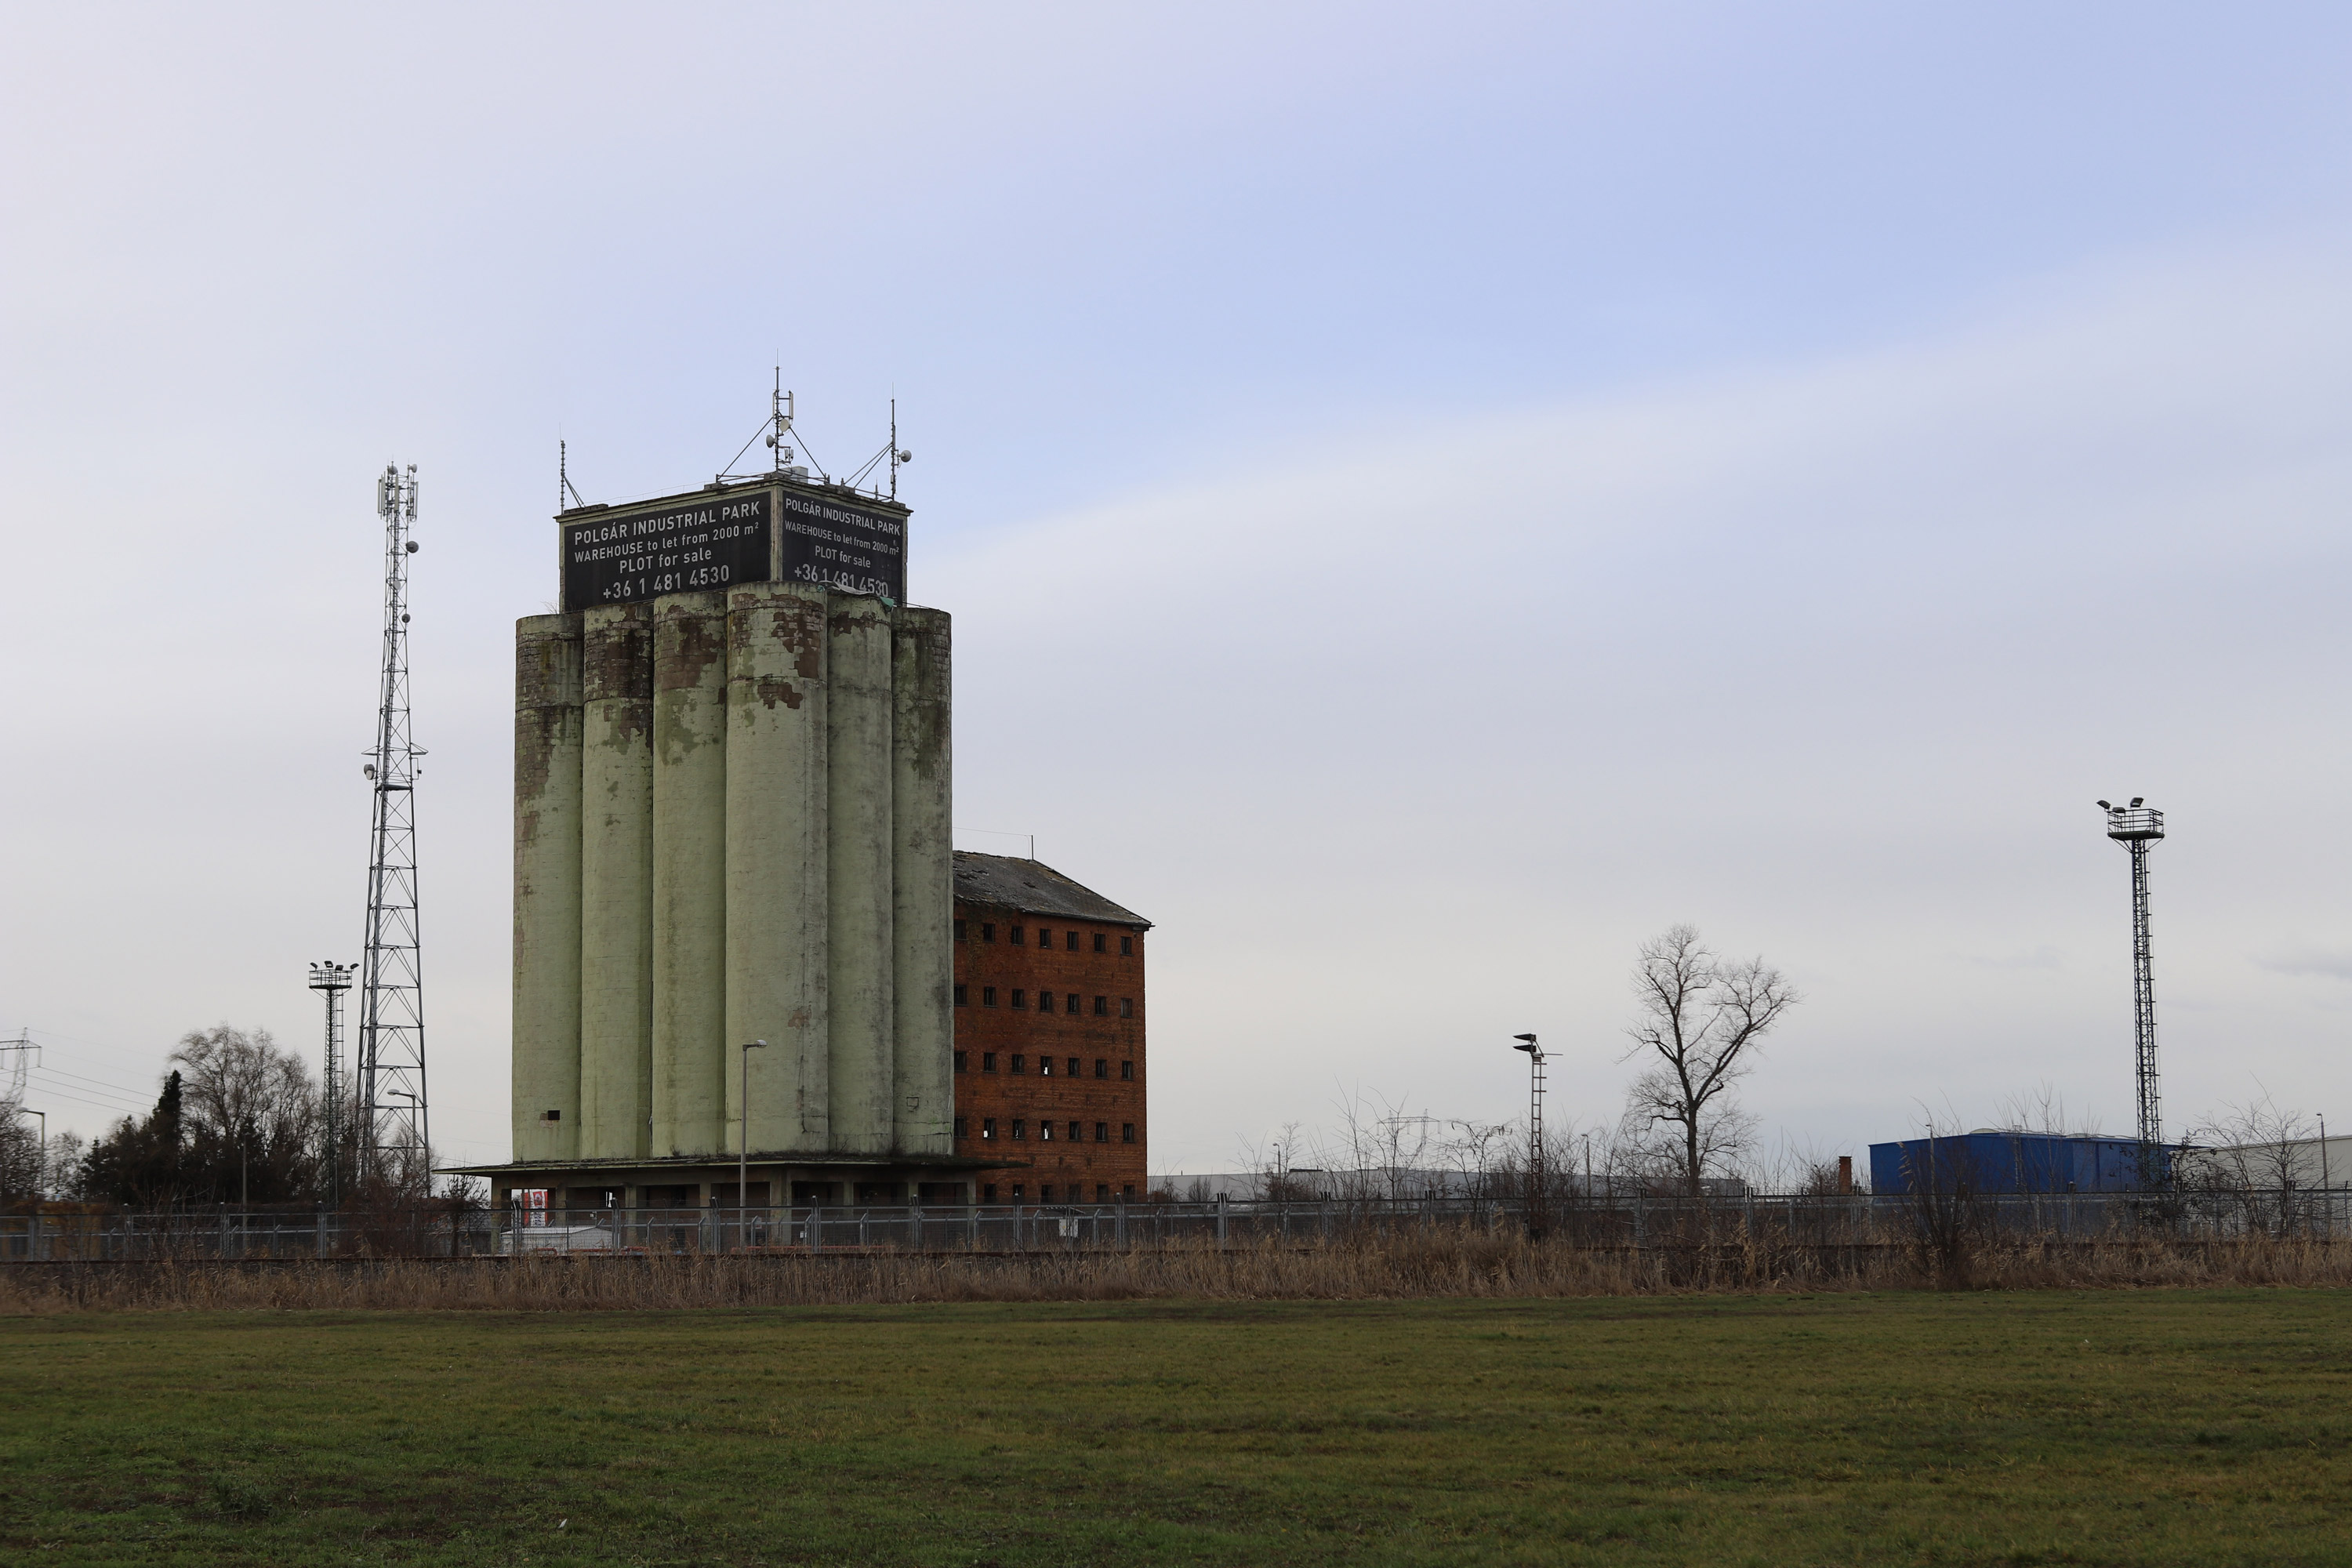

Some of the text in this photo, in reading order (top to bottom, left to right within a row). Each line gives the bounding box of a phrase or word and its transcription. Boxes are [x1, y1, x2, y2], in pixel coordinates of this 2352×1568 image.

[575, 501, 760, 545] POLGÁR INDUSTRIAL PARK
[786, 498, 901, 535] POLGÁR INDUSTRIAL PARK
[575, 541, 644, 563] WAREHOUSE
[648, 540, 658, 550] to
[662, 536, 677, 549] let
[681, 533, 708, 546] from
[713, 525, 739, 541] 2000
[785, 520, 832, 540] WAREHOUSE
[833, 533, 841, 543] to
[843, 535, 852, 544] let
[854, 538, 870, 550] from
[873, 541, 887, 554] 2000
[619, 547, 712, 574] PLOT for sale
[815, 545, 871, 568] PLOT for sale
[604, 564, 729, 599] +36 1 481 4530
[794, 564, 818, 583] +36
[822, 568, 827, 581] 1
[859, 576, 888, 597] 4530
